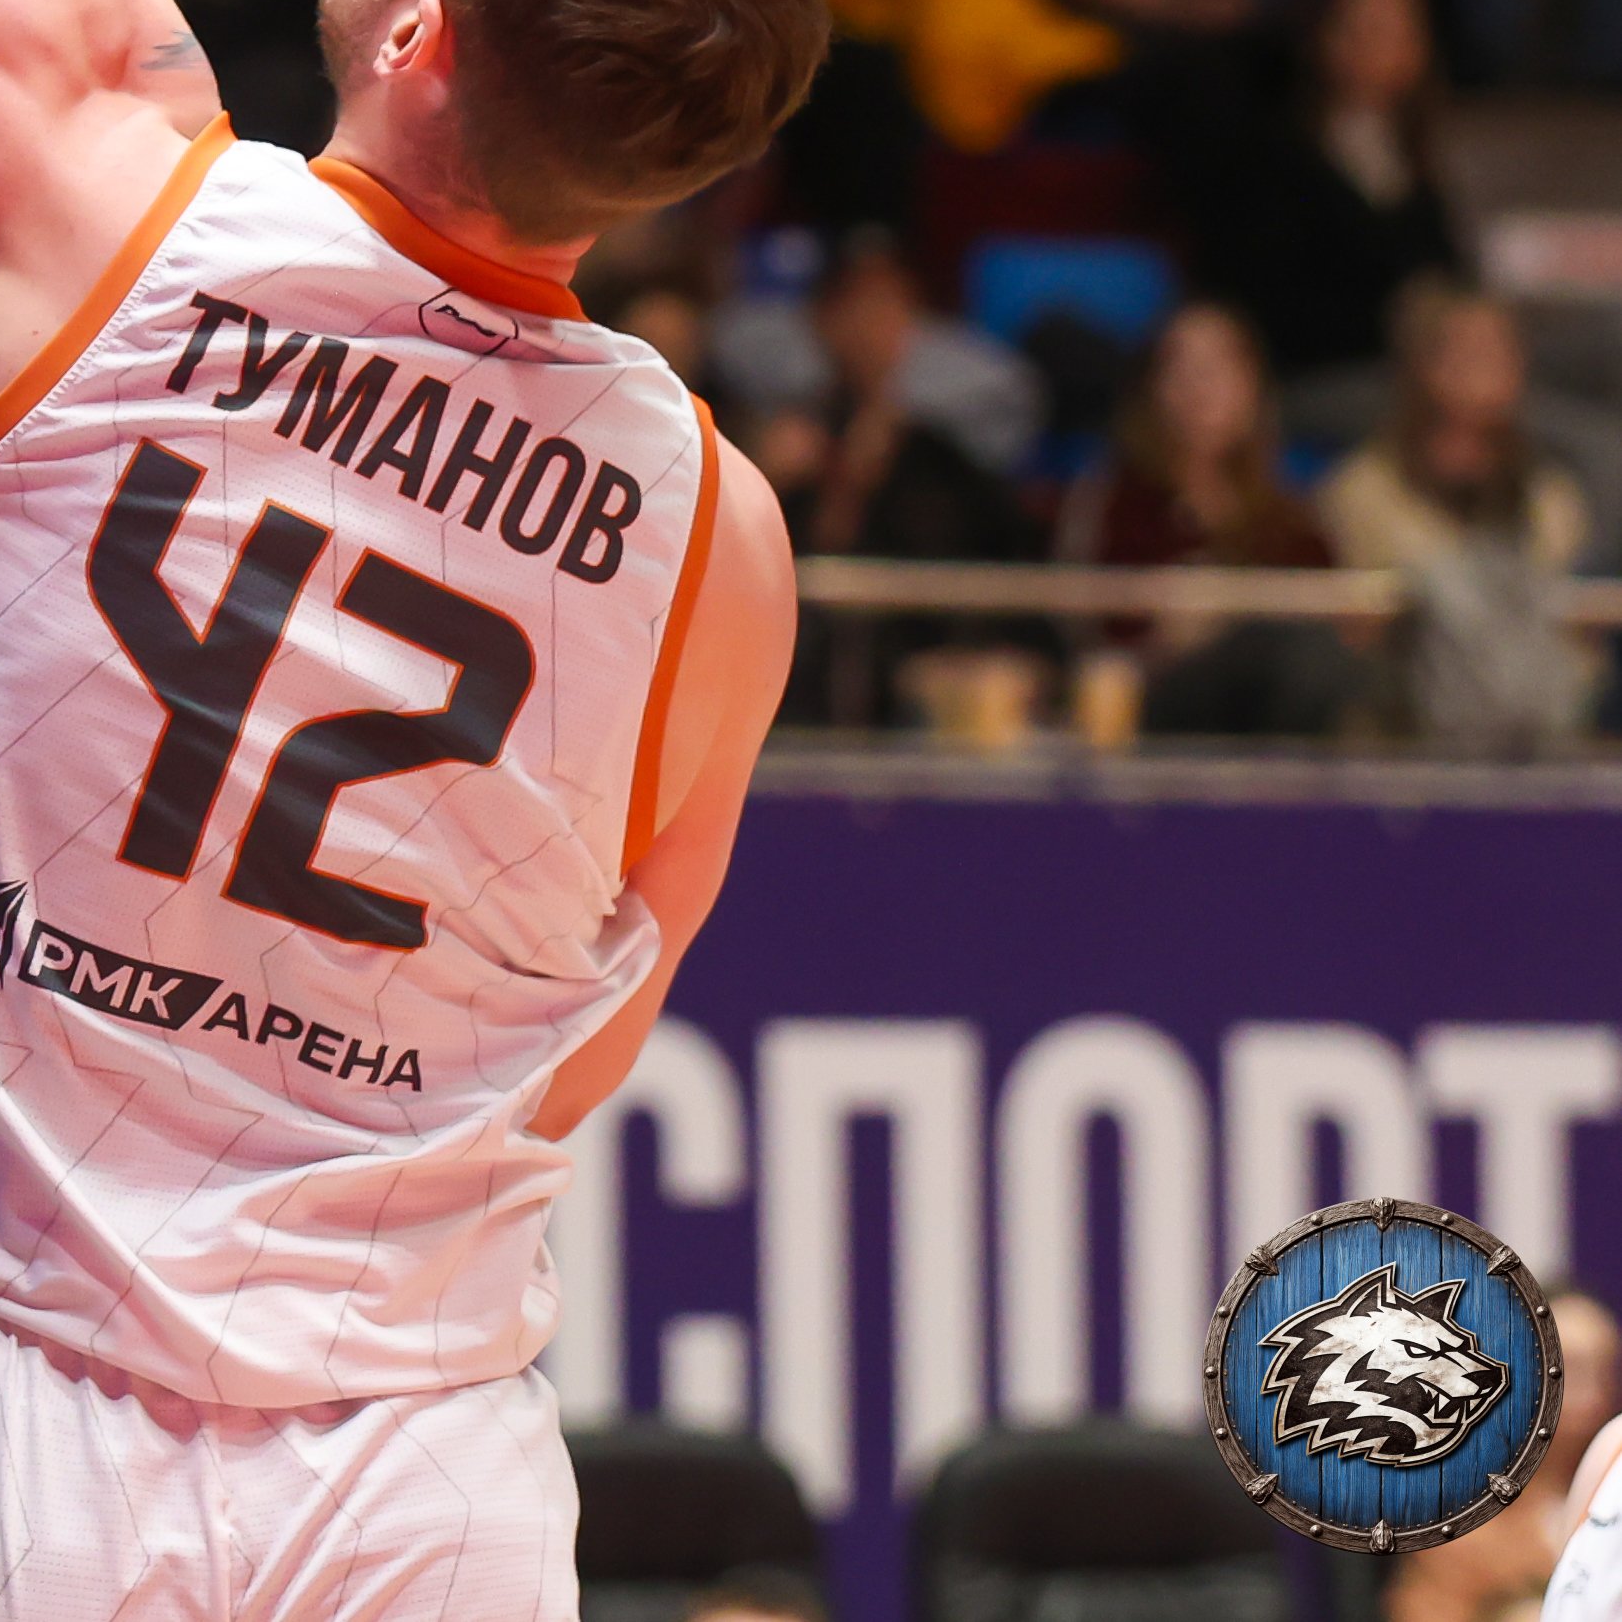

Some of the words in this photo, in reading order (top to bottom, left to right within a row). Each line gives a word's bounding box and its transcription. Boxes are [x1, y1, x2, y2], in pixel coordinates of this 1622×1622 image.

[165, 289, 642, 584] ТУМАНОВ
[85, 436, 536, 952] 42
[27, 928, 184, 1020] РМК
[201, 991, 423, 1093] АРЕНА
